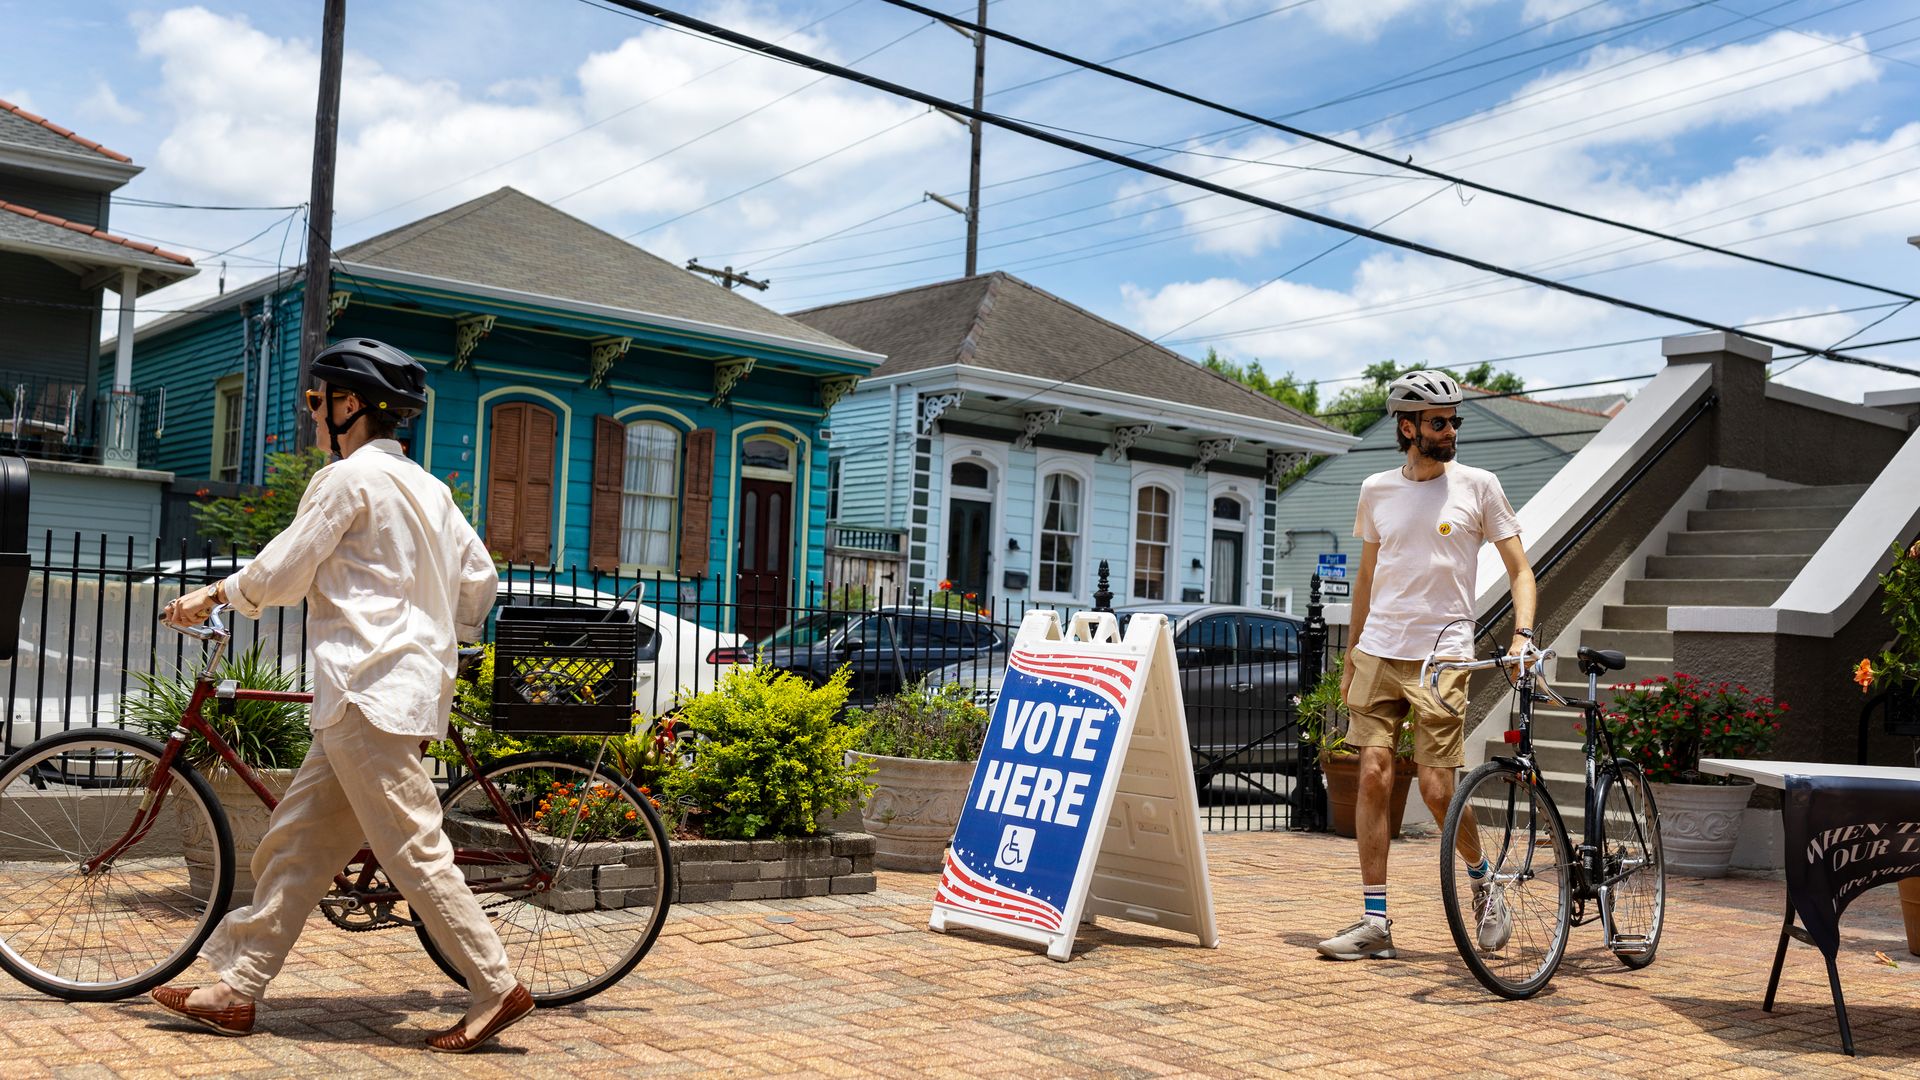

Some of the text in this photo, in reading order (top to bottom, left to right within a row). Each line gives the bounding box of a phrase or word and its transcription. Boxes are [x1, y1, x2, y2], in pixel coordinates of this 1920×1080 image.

[1000, 699, 1108, 762] VOTE
[975, 760, 1092, 828] HERE
[1807, 822, 1888, 864] WHEN
[1833, 839, 1891, 872] OUR
[1839, 876, 1867, 897] are
